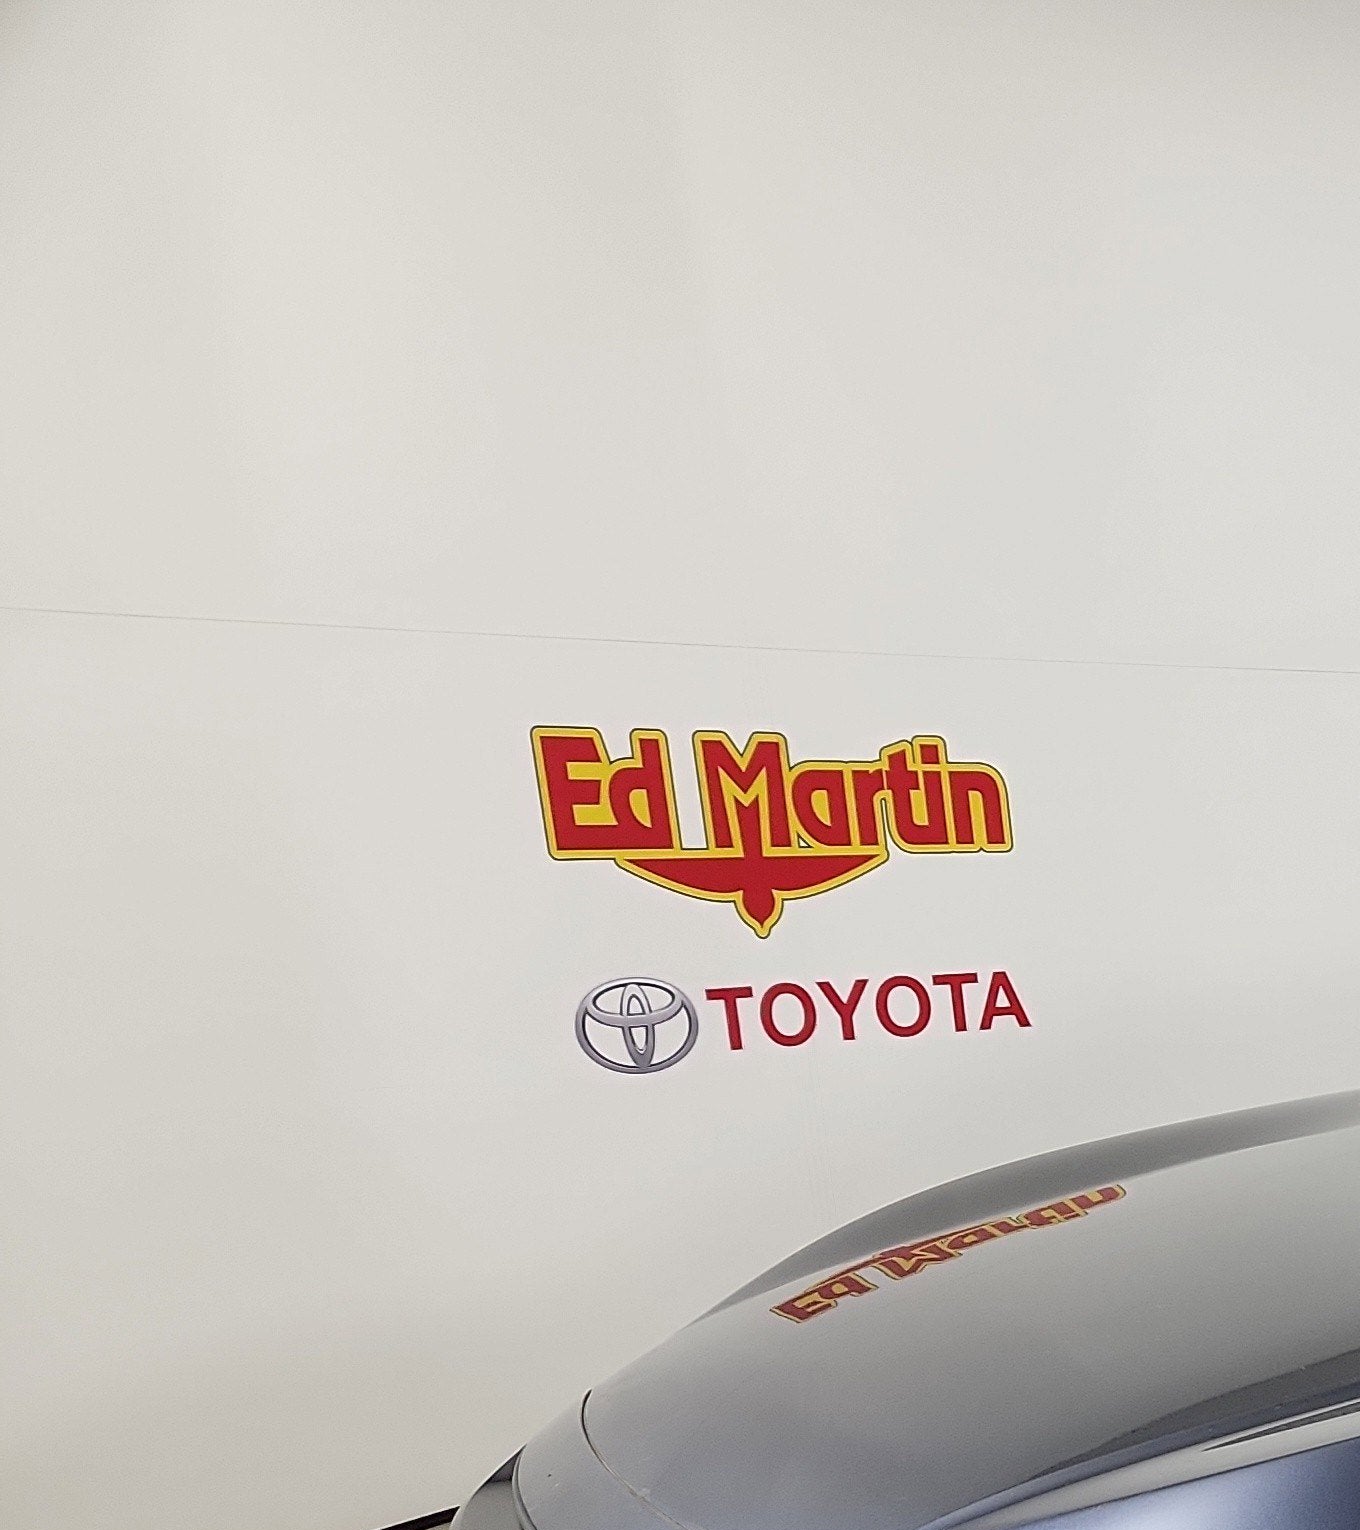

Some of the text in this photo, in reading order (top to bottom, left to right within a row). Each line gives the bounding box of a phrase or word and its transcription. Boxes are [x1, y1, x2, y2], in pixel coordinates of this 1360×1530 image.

[535, 731, 1010, 855] Ed Martin
[705, 969, 1032, 1051] TOYOTA
